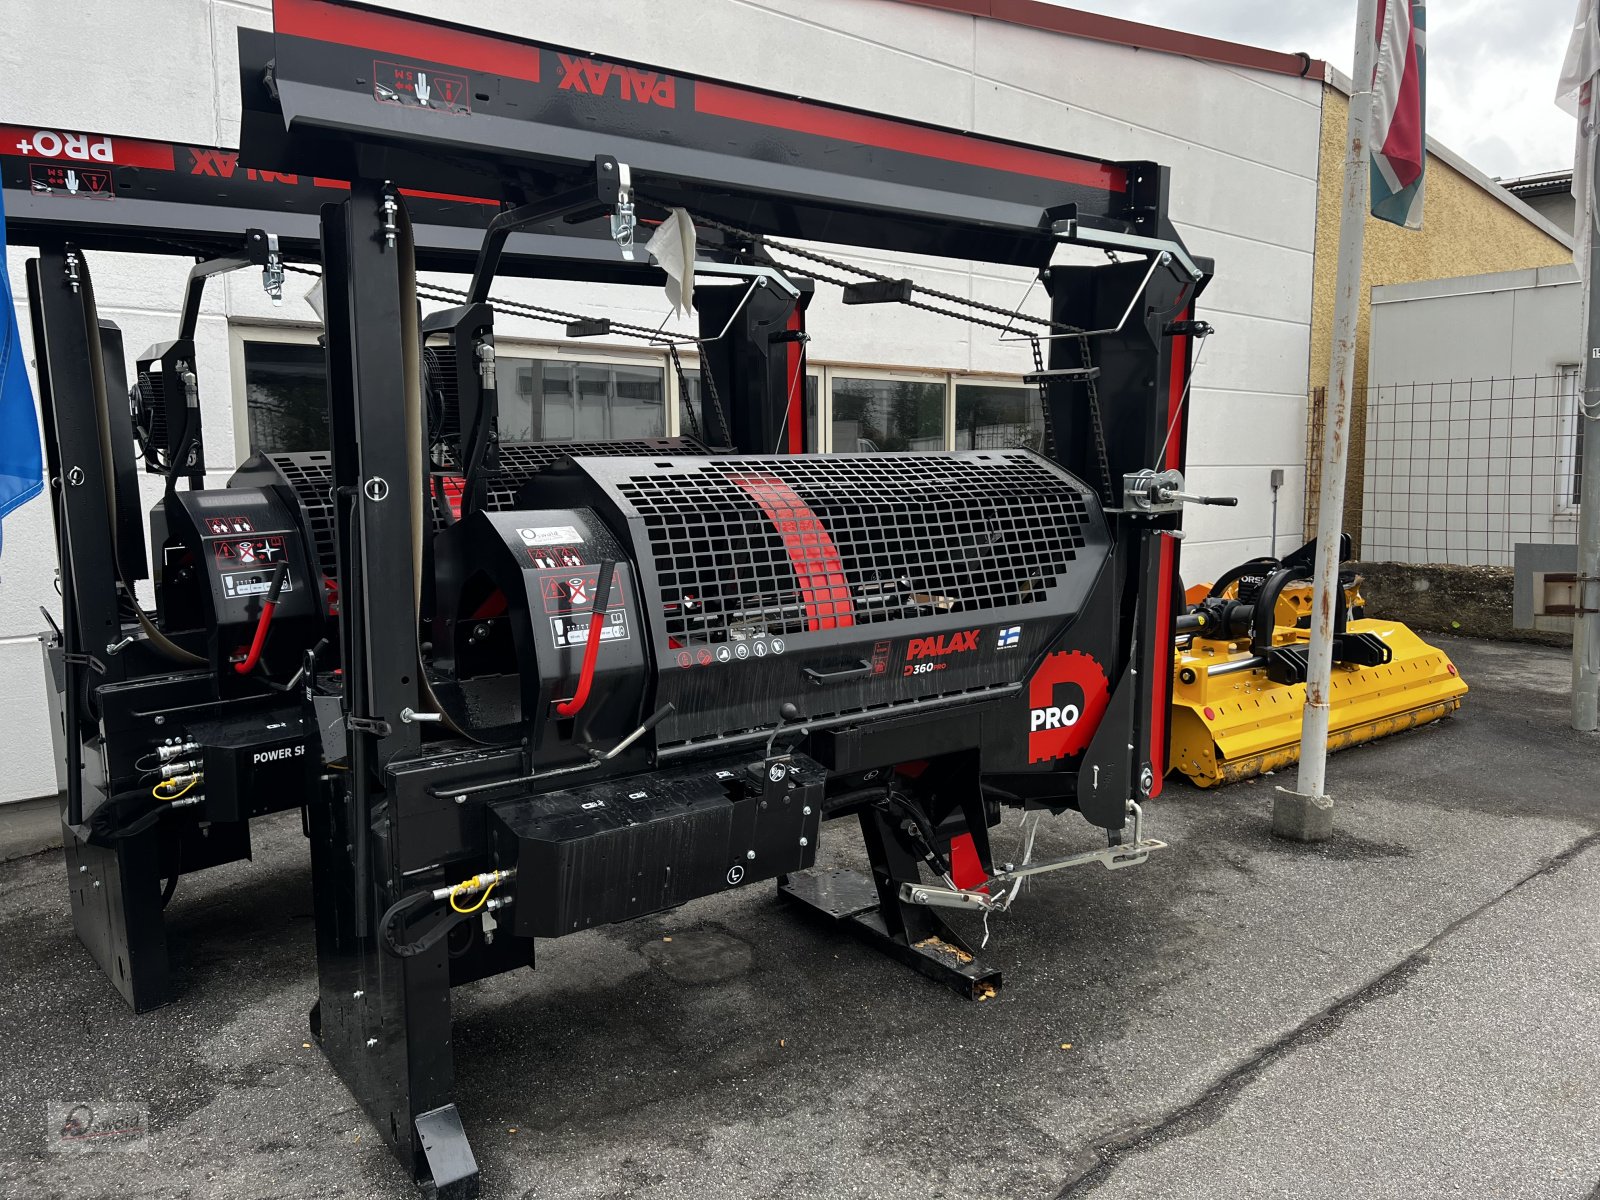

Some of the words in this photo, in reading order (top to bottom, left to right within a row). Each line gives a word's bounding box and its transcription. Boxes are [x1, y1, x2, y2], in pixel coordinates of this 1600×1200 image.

[394, 69, 404, 79] M
[406, 72, 413, 80] 5
[557, 53, 676, 109] PALAX
[16, 130, 114, 162] PRO+
[47, 168, 56, 176] M
[57, 169, 63, 177] 5
[906, 629, 980, 661] PALAX
[1030, 704, 1079, 732] PRO
[253, 747, 292, 764] POWER
